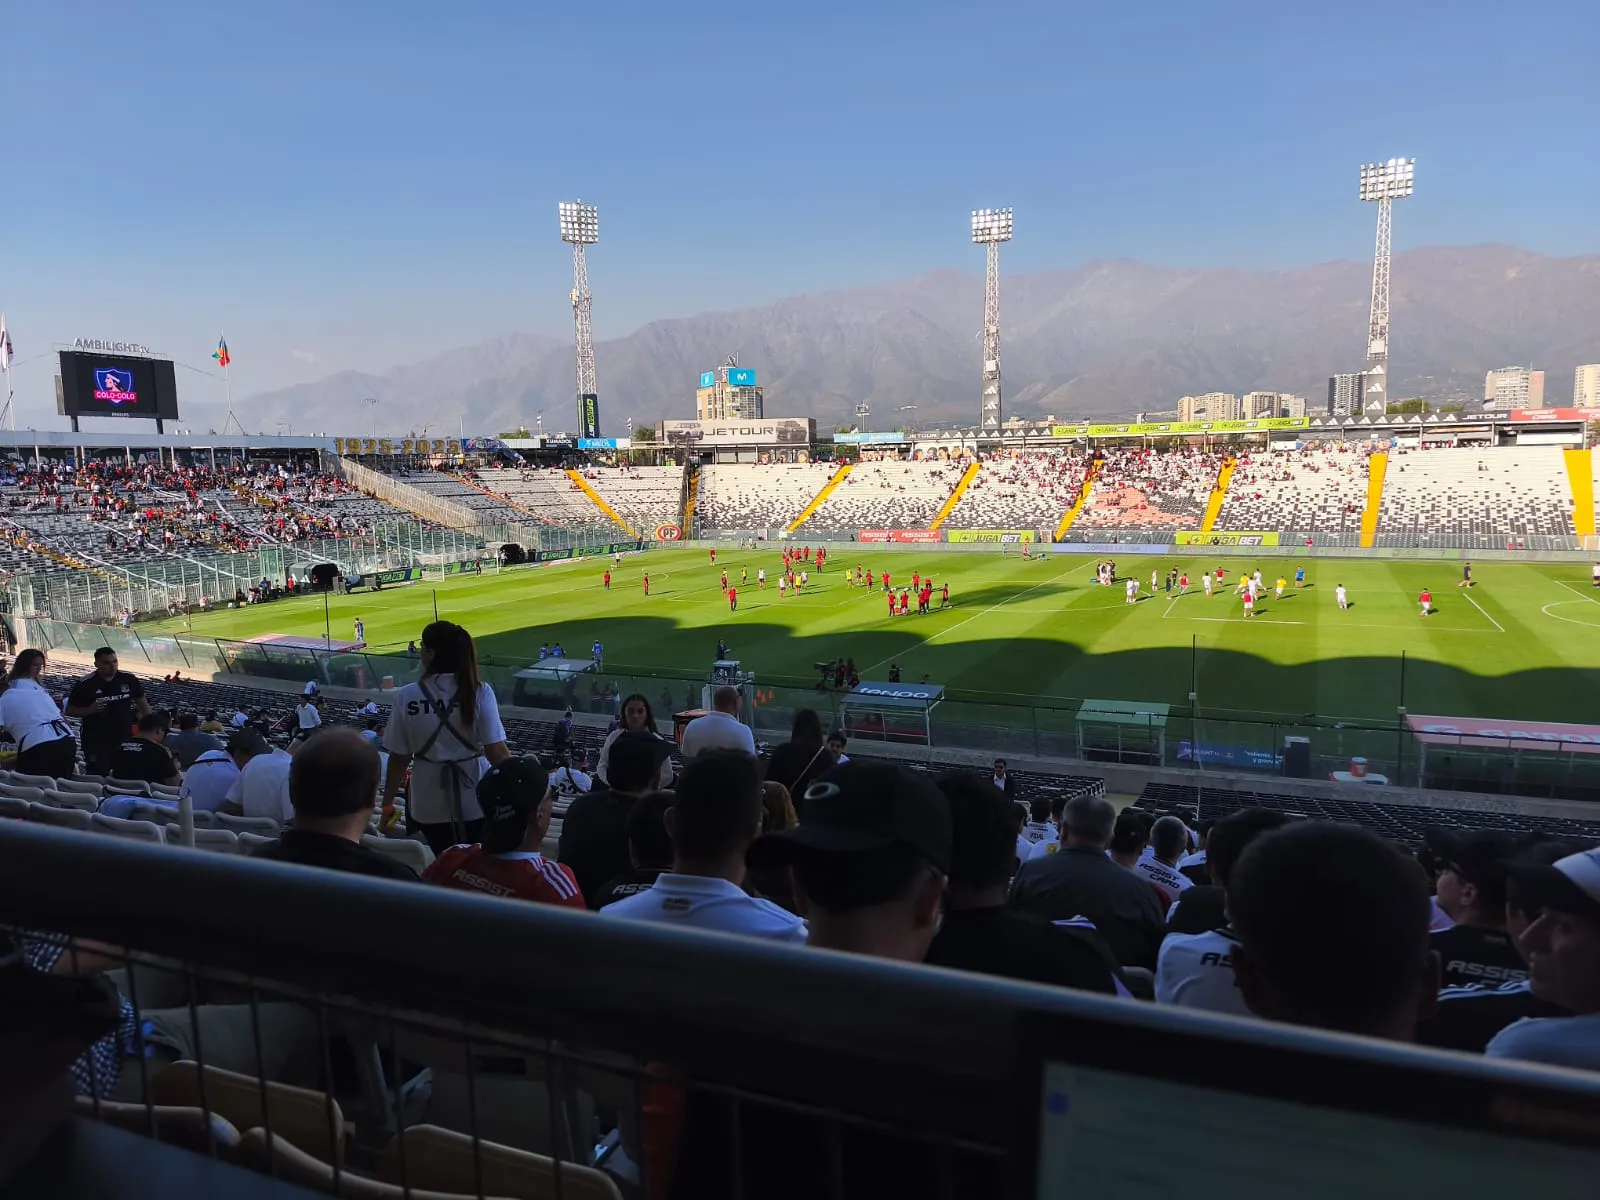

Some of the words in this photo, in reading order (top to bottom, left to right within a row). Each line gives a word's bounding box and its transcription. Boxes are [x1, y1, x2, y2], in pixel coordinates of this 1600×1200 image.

[73, 337, 139, 353] AMBILIGHT
[96, 391, 135, 400] COLO-COLO
[705, 427, 774, 436] JETOUR
[335, 438, 461, 454] 1925-2025
[662, 528, 675, 537] PF
[973, 533, 1021, 543] JUGABET
[1139, 863, 1180, 881] ASSIST
[452, 868, 516, 897] ASSIST
[1149, 873, 1180, 889] CARD
